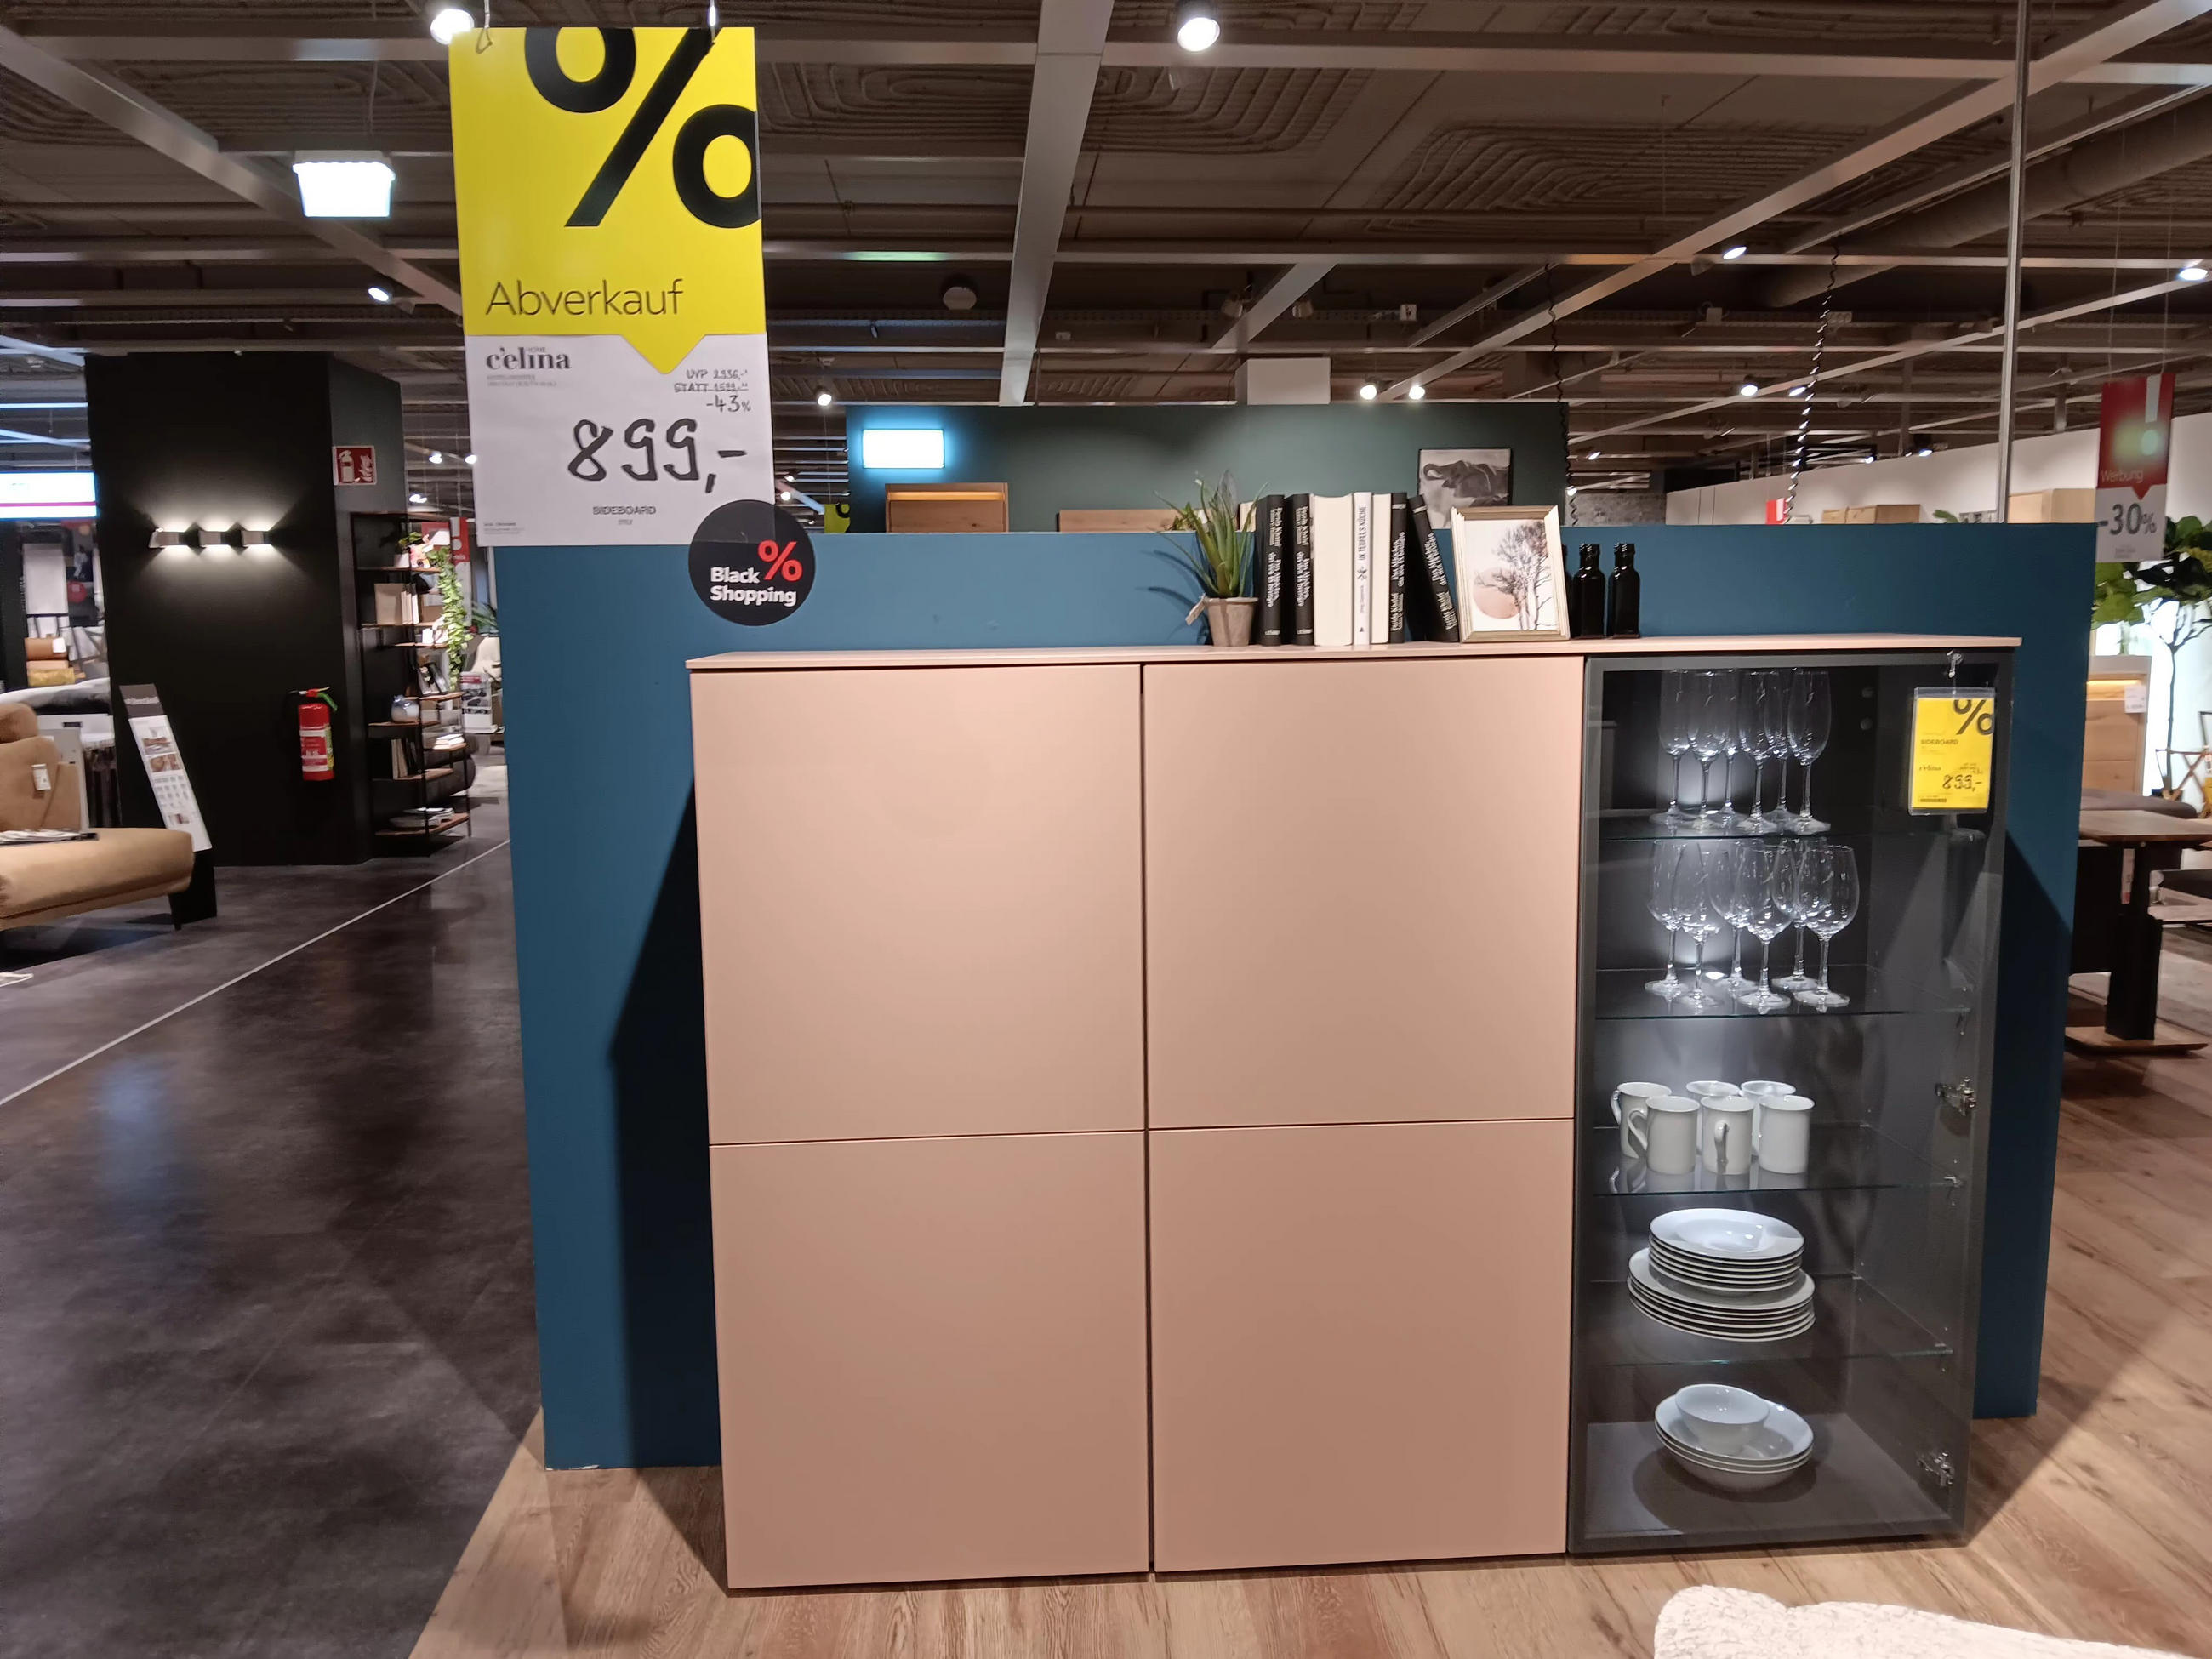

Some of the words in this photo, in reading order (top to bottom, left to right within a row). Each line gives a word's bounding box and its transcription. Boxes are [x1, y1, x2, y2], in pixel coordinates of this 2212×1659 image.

[485, 278, 684, 316] Abverkauf
[686, 368, 709, 379] UVP
[674, 382, 709, 392] STATT
[705, 394, 752, 413] -43%
[567, 418, 748, 493] 899,-
[2101, 469, 2144, 484] Werbung
[592, 505, 657, 516] SIDEBOARD
[2097, 503, 2158, 536] -30%
[710, 566, 761, 584] Black
[757, 539, 804, 582] %
[710, 584, 797, 607] Shopping
